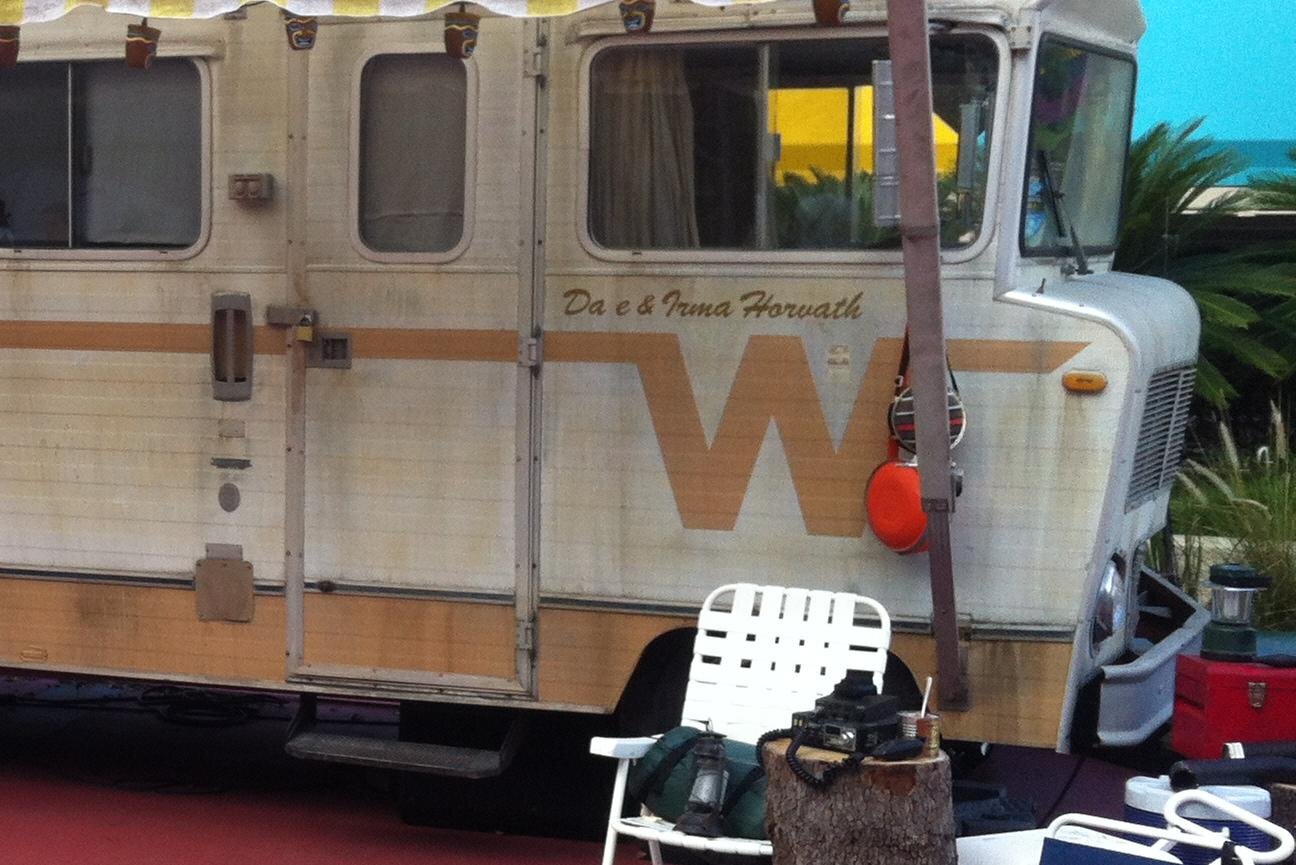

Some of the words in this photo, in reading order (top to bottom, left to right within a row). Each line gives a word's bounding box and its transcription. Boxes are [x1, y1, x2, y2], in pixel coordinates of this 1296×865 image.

[636, 293, 656, 316] &
[662, 289, 735, 319] Irma
[739, 289, 864, 320] Horvath
[634, 332, 908, 538] W
